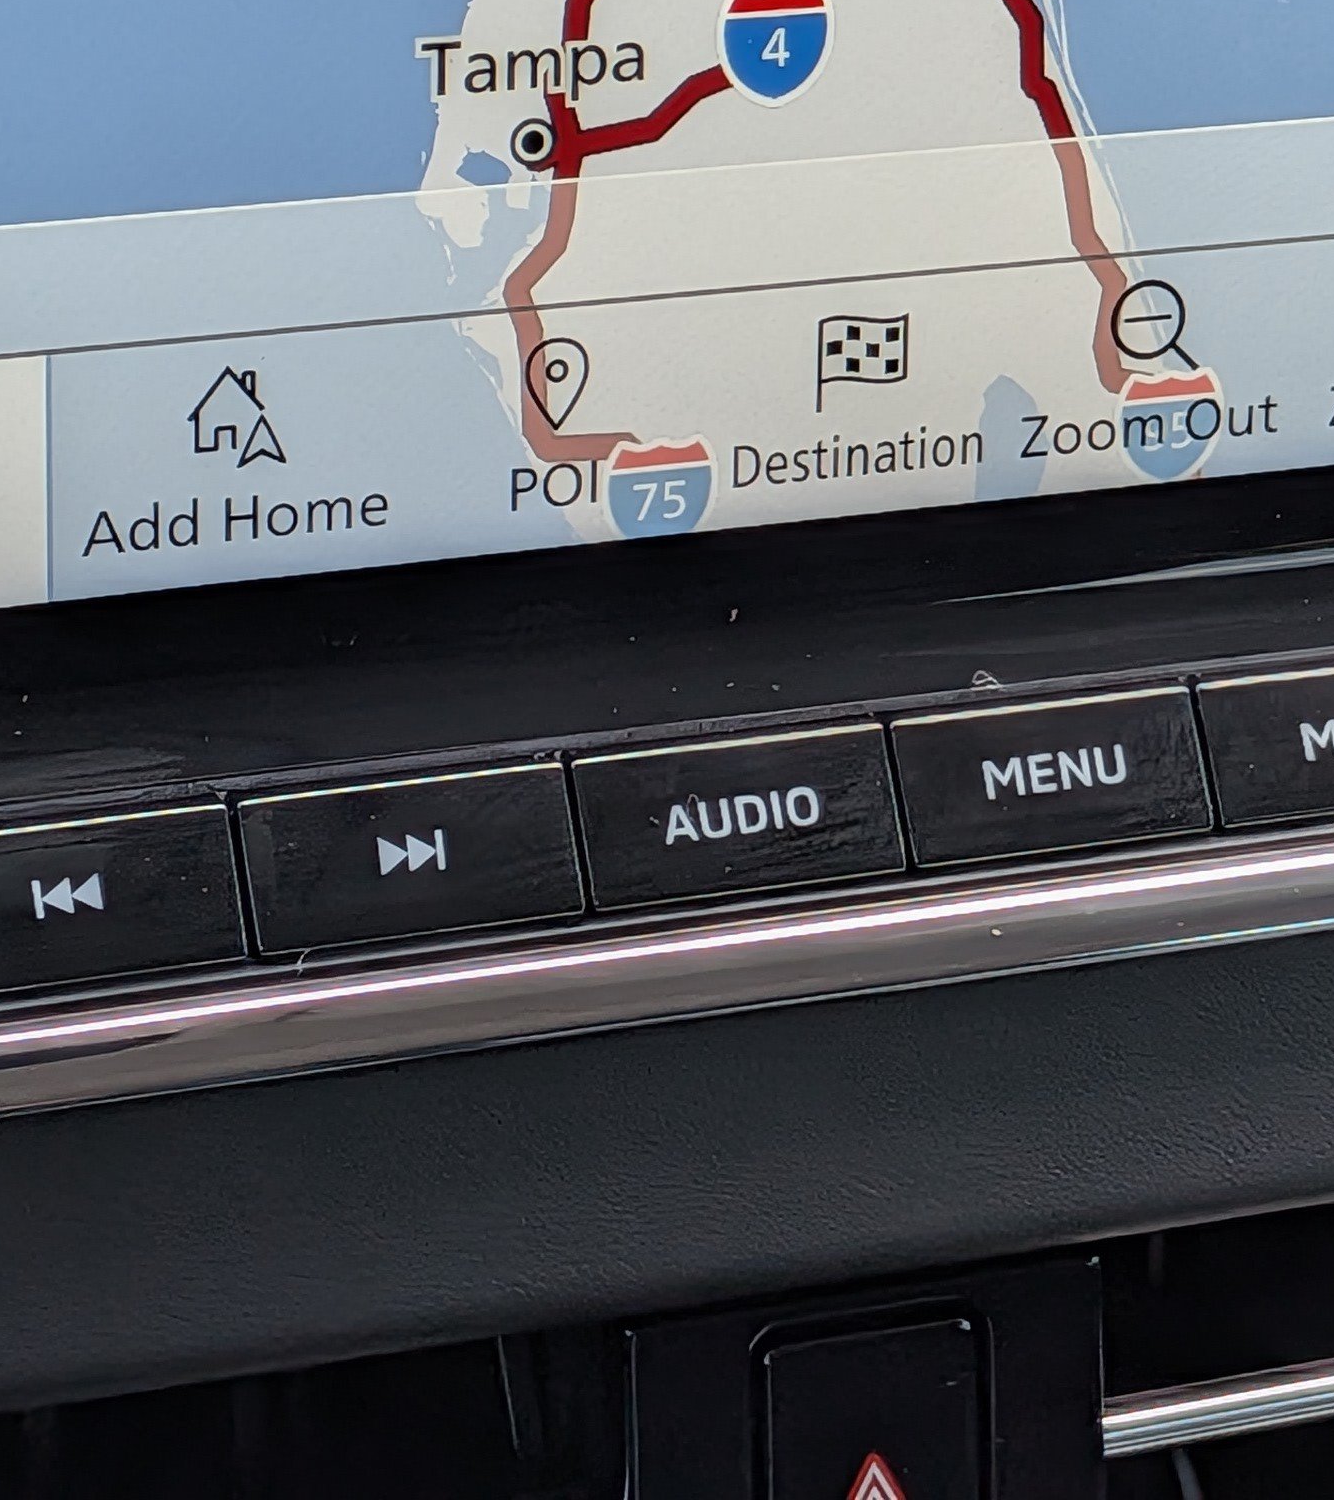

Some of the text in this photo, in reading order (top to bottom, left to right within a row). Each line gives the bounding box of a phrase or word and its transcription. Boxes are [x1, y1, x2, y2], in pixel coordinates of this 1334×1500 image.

[420, 40, 645, 102] Tampa
[760, 26, 791, 68] 4
[732, 425, 985, 489] Destination
[1020, 394, 1279, 459] Zoom Out
[510, 459, 598, 511] POI
[632, 479, 687, 522] 75
[81, 490, 390, 558] Add Home
[982, 742, 1129, 801] MENU
[664, 786, 821, 847] AUDIO
